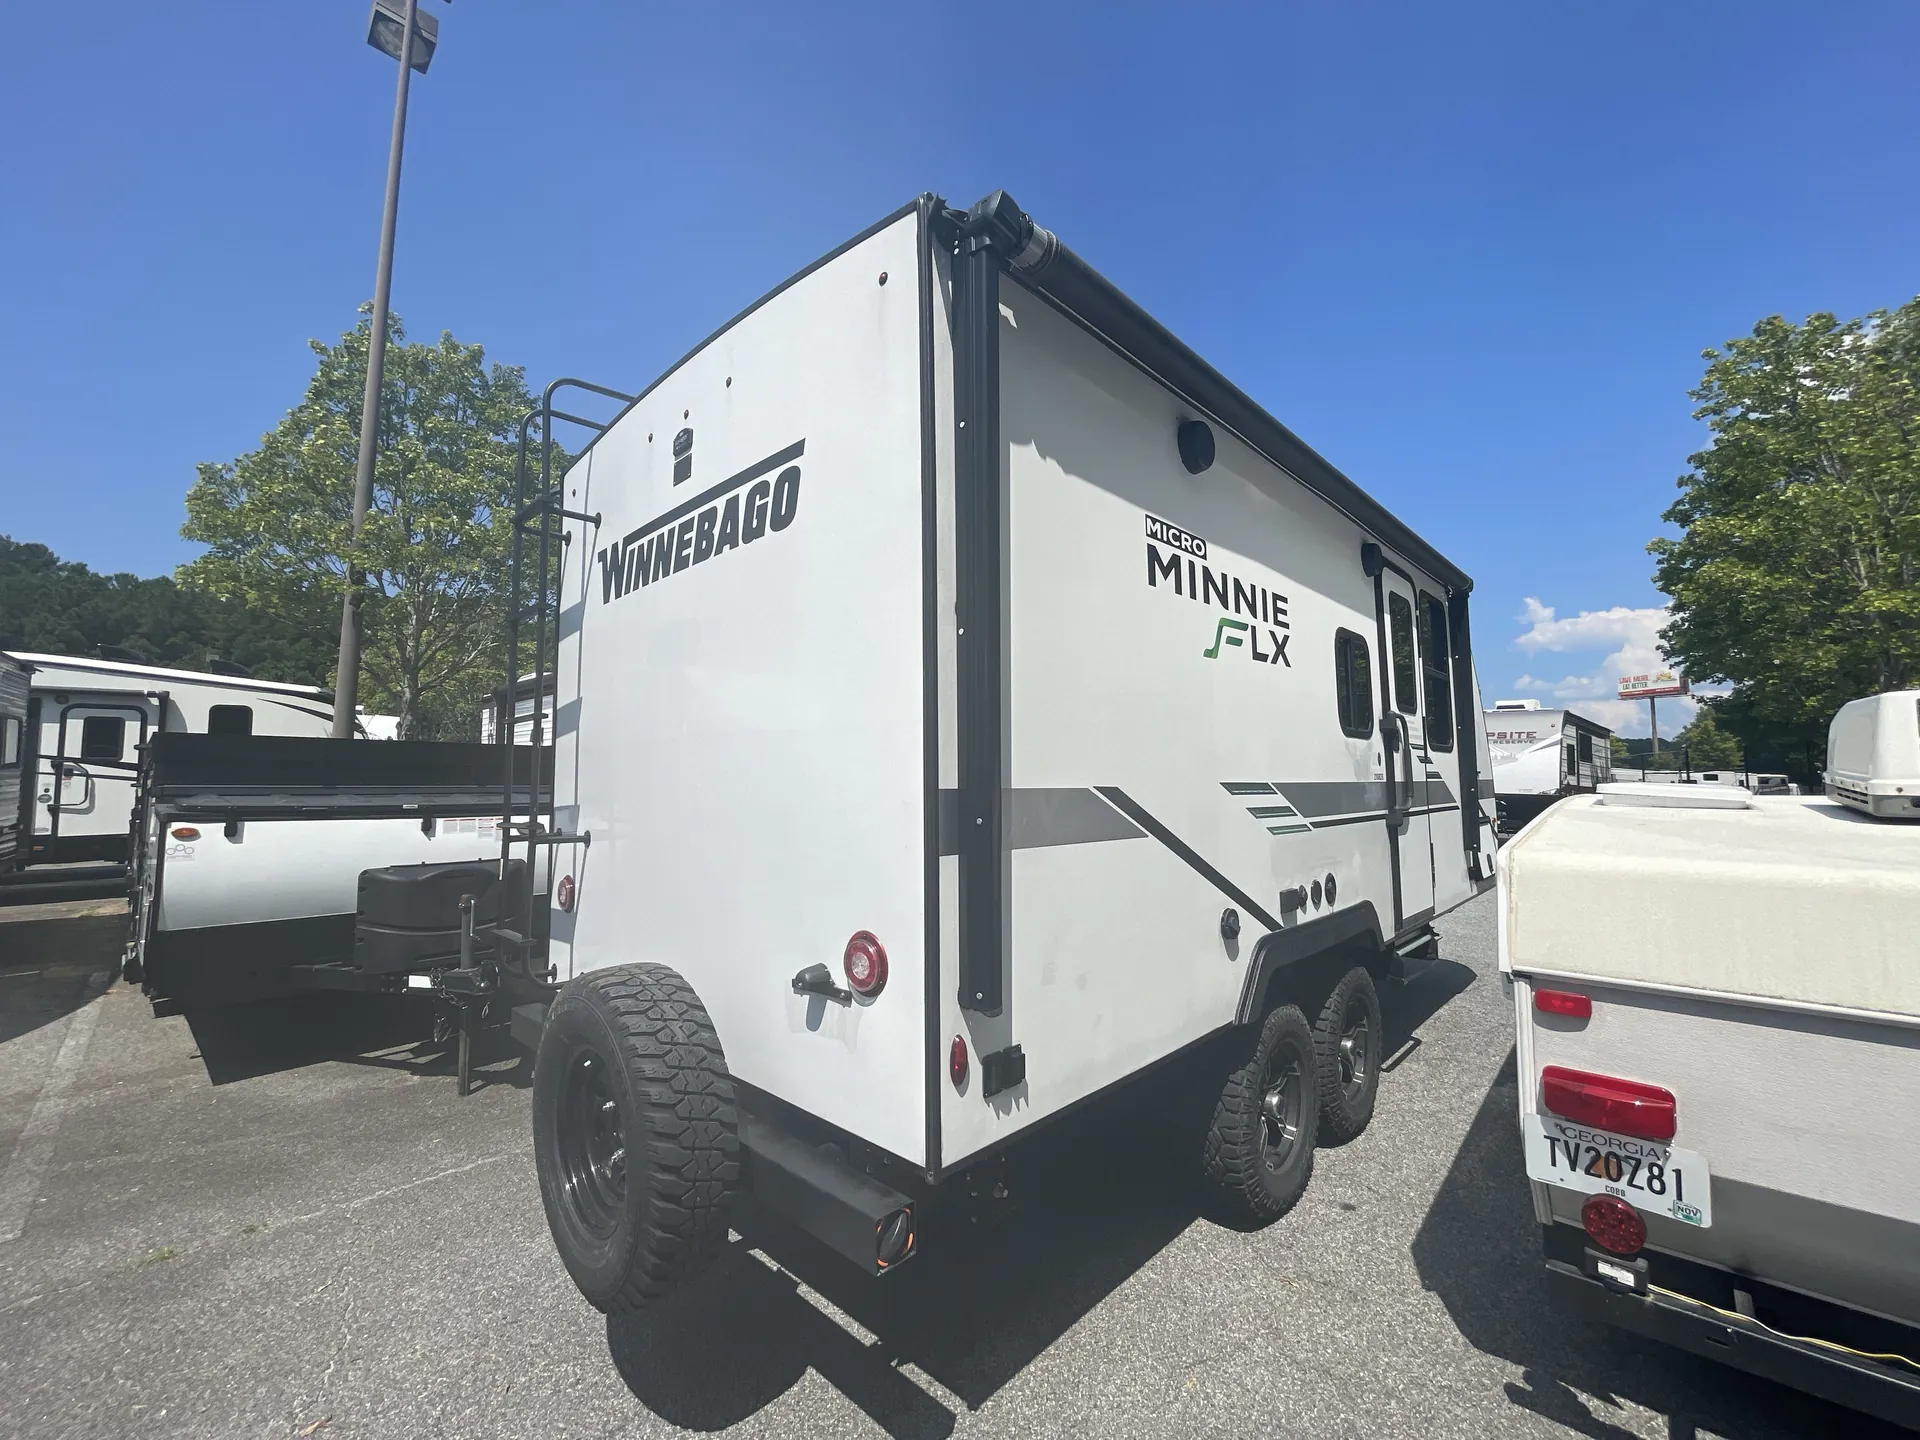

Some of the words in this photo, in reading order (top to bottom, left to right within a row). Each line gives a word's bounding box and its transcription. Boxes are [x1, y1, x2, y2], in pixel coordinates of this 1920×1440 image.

[598, 465, 802, 605] WINNEBAGO
[1145, 516, 1206, 557] MICRO
[1146, 542, 1290, 629] MINNIE
[1203, 617, 1291, 668] FLX
[1618, 676, 1631, 684] SAVE
[1563, 1126, 1662, 1162] GEORGIA
[1543, 1134, 1684, 1202] TV20Z81
[1605, 1185, 1626, 1197] COBB
[1677, 1205, 1699, 1217] NOV
